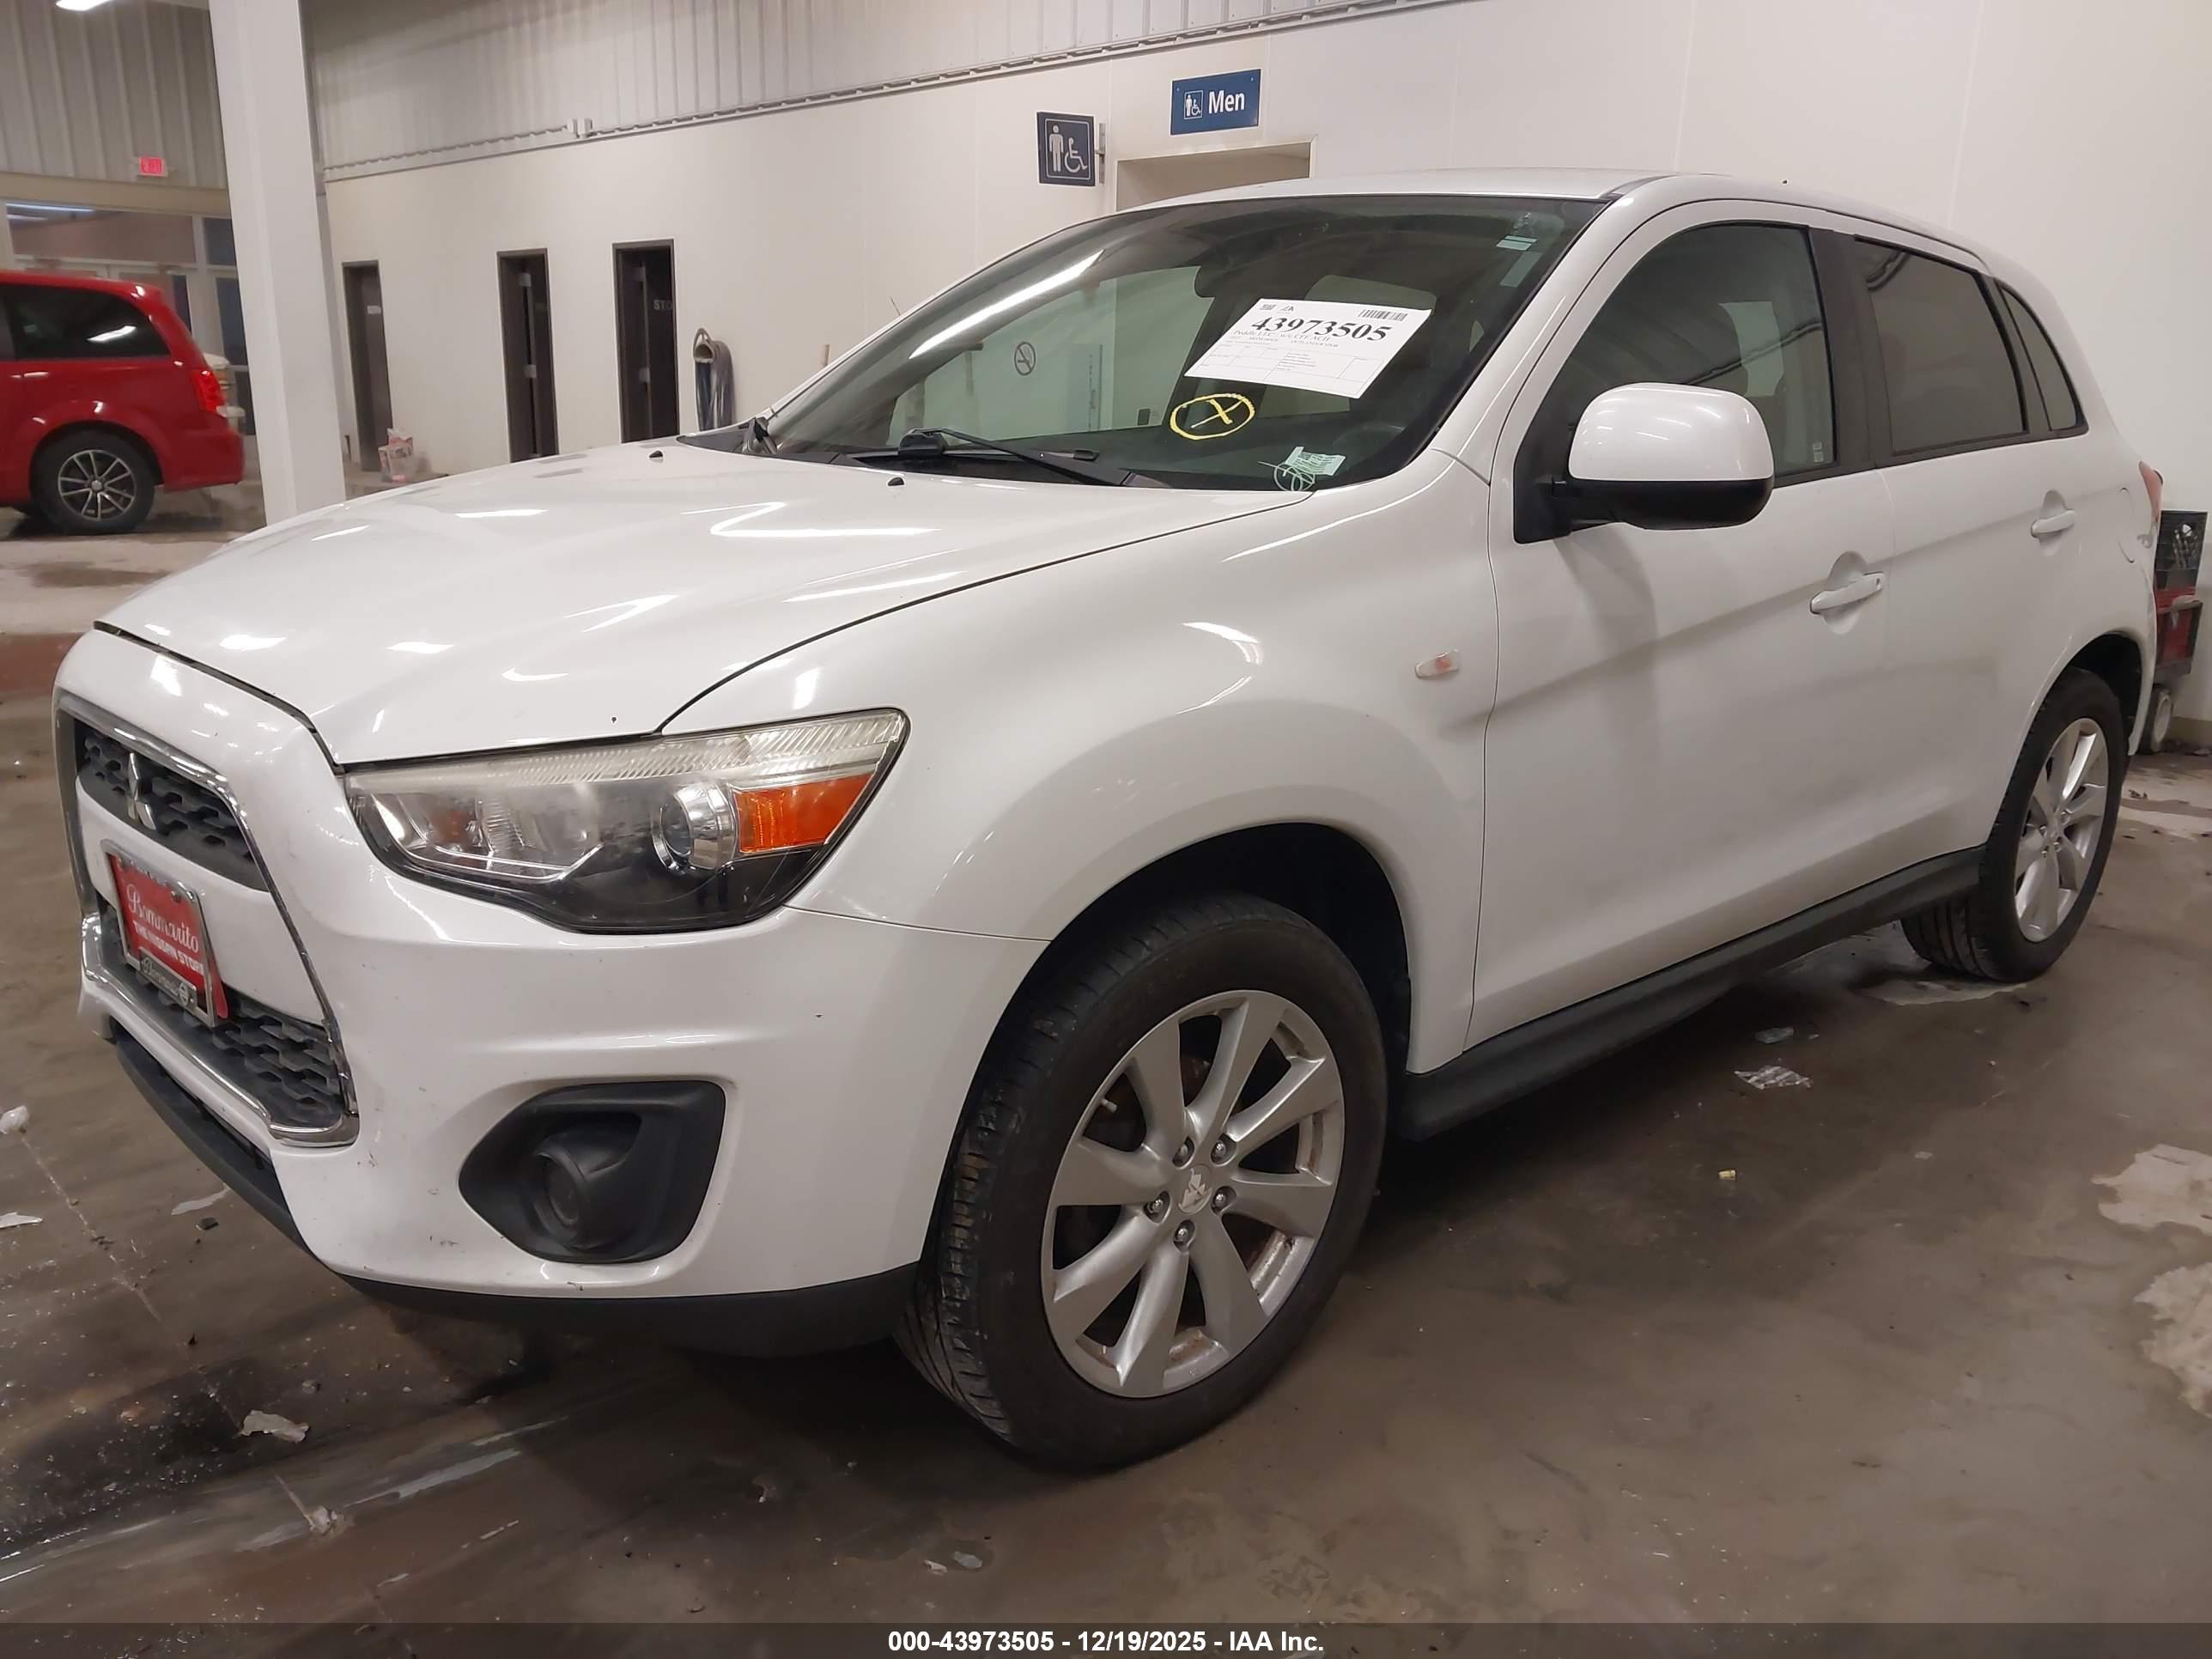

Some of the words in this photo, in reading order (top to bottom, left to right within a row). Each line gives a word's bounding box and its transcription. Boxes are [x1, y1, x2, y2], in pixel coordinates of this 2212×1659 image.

[1208, 89, 1245, 114] Men
[1250, 316, 1393, 342] 43973505
[126, 884, 199, 953] Bommarito
